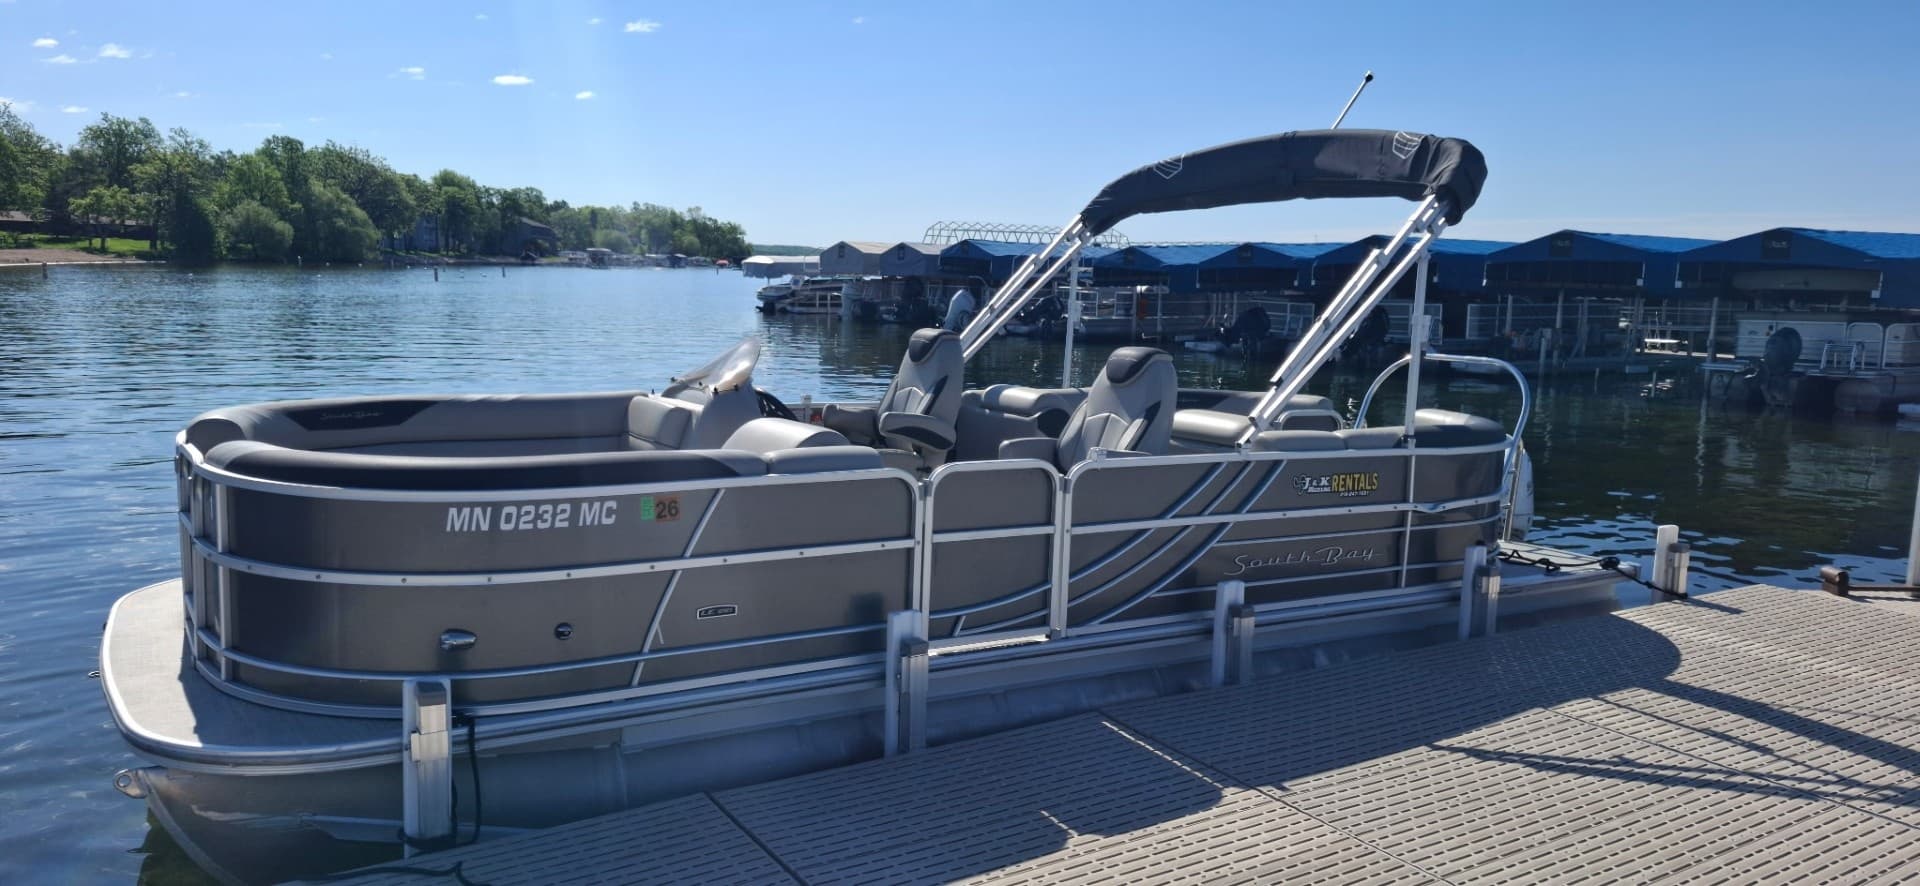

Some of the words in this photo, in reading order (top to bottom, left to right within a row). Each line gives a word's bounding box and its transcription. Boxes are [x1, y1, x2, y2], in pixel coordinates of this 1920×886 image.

[1320, 476, 1330, 486] K
[1331, 472, 1378, 492] RENTALS
[446, 507, 491, 532] MN
[500, 503, 570, 530] 0232
[579, 500, 617, 526] MC
[656, 500, 679, 519] 26
[1224, 551, 1311, 576] South
[1316, 546, 1384, 567] Bay
